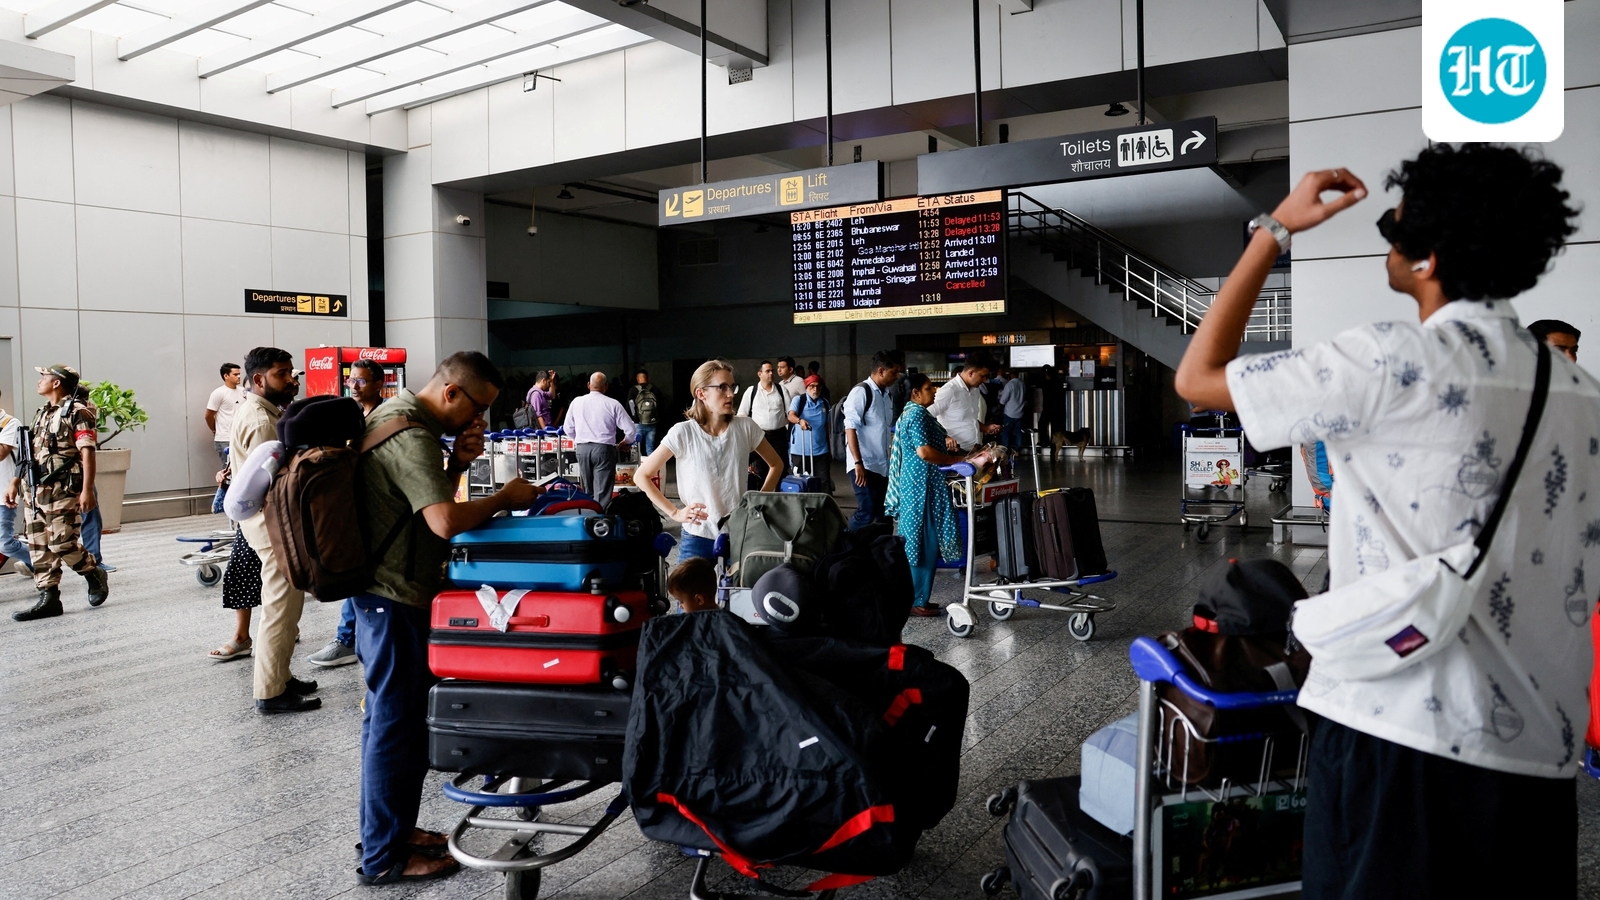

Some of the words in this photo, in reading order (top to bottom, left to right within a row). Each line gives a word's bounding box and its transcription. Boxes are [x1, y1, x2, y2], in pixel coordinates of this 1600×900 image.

[1060, 139, 1111, 156] Toilets
[1071, 159, 1111, 172] शौचालय
[808, 173, 827, 188] Lift
[707, 181, 771, 201] Departures
[793, 212, 811, 222] STA
[814, 209, 838, 218] Flight
[850, 203, 892, 215] From/Via
[918, 197, 940, 207] ETA
[944, 195, 975, 204] Status
[815, 221, 824, 229] 6E
[827, 219, 843, 228] 2402
[851, 217, 864, 225] Leh
[919, 208, 939, 217] 14:54
[793, 232, 811, 241] 09:55
[816, 231, 824, 239] 6E
[851, 224, 900, 235] Bhubaneswar
[919, 219, 939, 228] 11:53
[945, 215, 976, 225] Delayed
[978, 212, 1000, 221] 11:53
[793, 242, 811, 251] 12:55
[816, 241, 824, 249] 6E
[827, 239, 843, 248] 2015
[852, 238, 865, 246] Leh
[919, 230, 939, 239] 13:28
[945, 225, 977, 236] Delayed
[979, 224, 1000, 233] 13:28
[793, 252, 812, 261] 13:00
[816, 251, 824, 259] 6E
[827, 249, 843, 258] 2102
[920, 240, 940, 249] 12:52
[944, 237, 973, 247] Arrived
[976, 235, 995, 244] 13:01
[794, 262, 812, 271] 13:00
[816, 261, 825, 269] 6E
[827, 259, 844, 268] 6042
[851, 256, 895, 266] Ahmedabad
[920, 251, 940, 260] 13:12
[946, 248, 974, 258] Landed
[794, 272, 812, 281] 13:05
[817, 271, 825, 279] 6E
[853, 267, 875, 277] Imphal
[882, 263, 916, 274] Guwahati
[945, 258, 974, 269] Arrived
[975, 257, 997, 266] 13:10
[794, 282, 812, 291] 13:10
[817, 281, 826, 289] 6E
[828, 280, 844, 289] 2137
[853, 278, 879, 287] Jammu
[886, 275, 917, 284] Srinagar
[920, 272, 941, 281] 12:54
[945, 269, 974, 279] Arrived
[795, 292, 813, 300] 13:10
[817, 291, 826, 299] 6E
[828, 290, 843, 299] 2221
[853, 287, 881, 296] Mumbai
[946, 280, 985, 289] Cancelled
[253, 293, 296, 303] Departures
[795, 302, 813, 310] 13:15
[817, 301, 826, 309] 6E
[829, 300, 845, 308] 2099
[853, 299, 881, 307] Udaipur
[921, 293, 941, 302] 13:18
[794, 314, 810, 322] Page
[845, 311, 862, 319] Delhi
[864, 308, 907, 317] International
[908, 307, 932, 315] Airport
